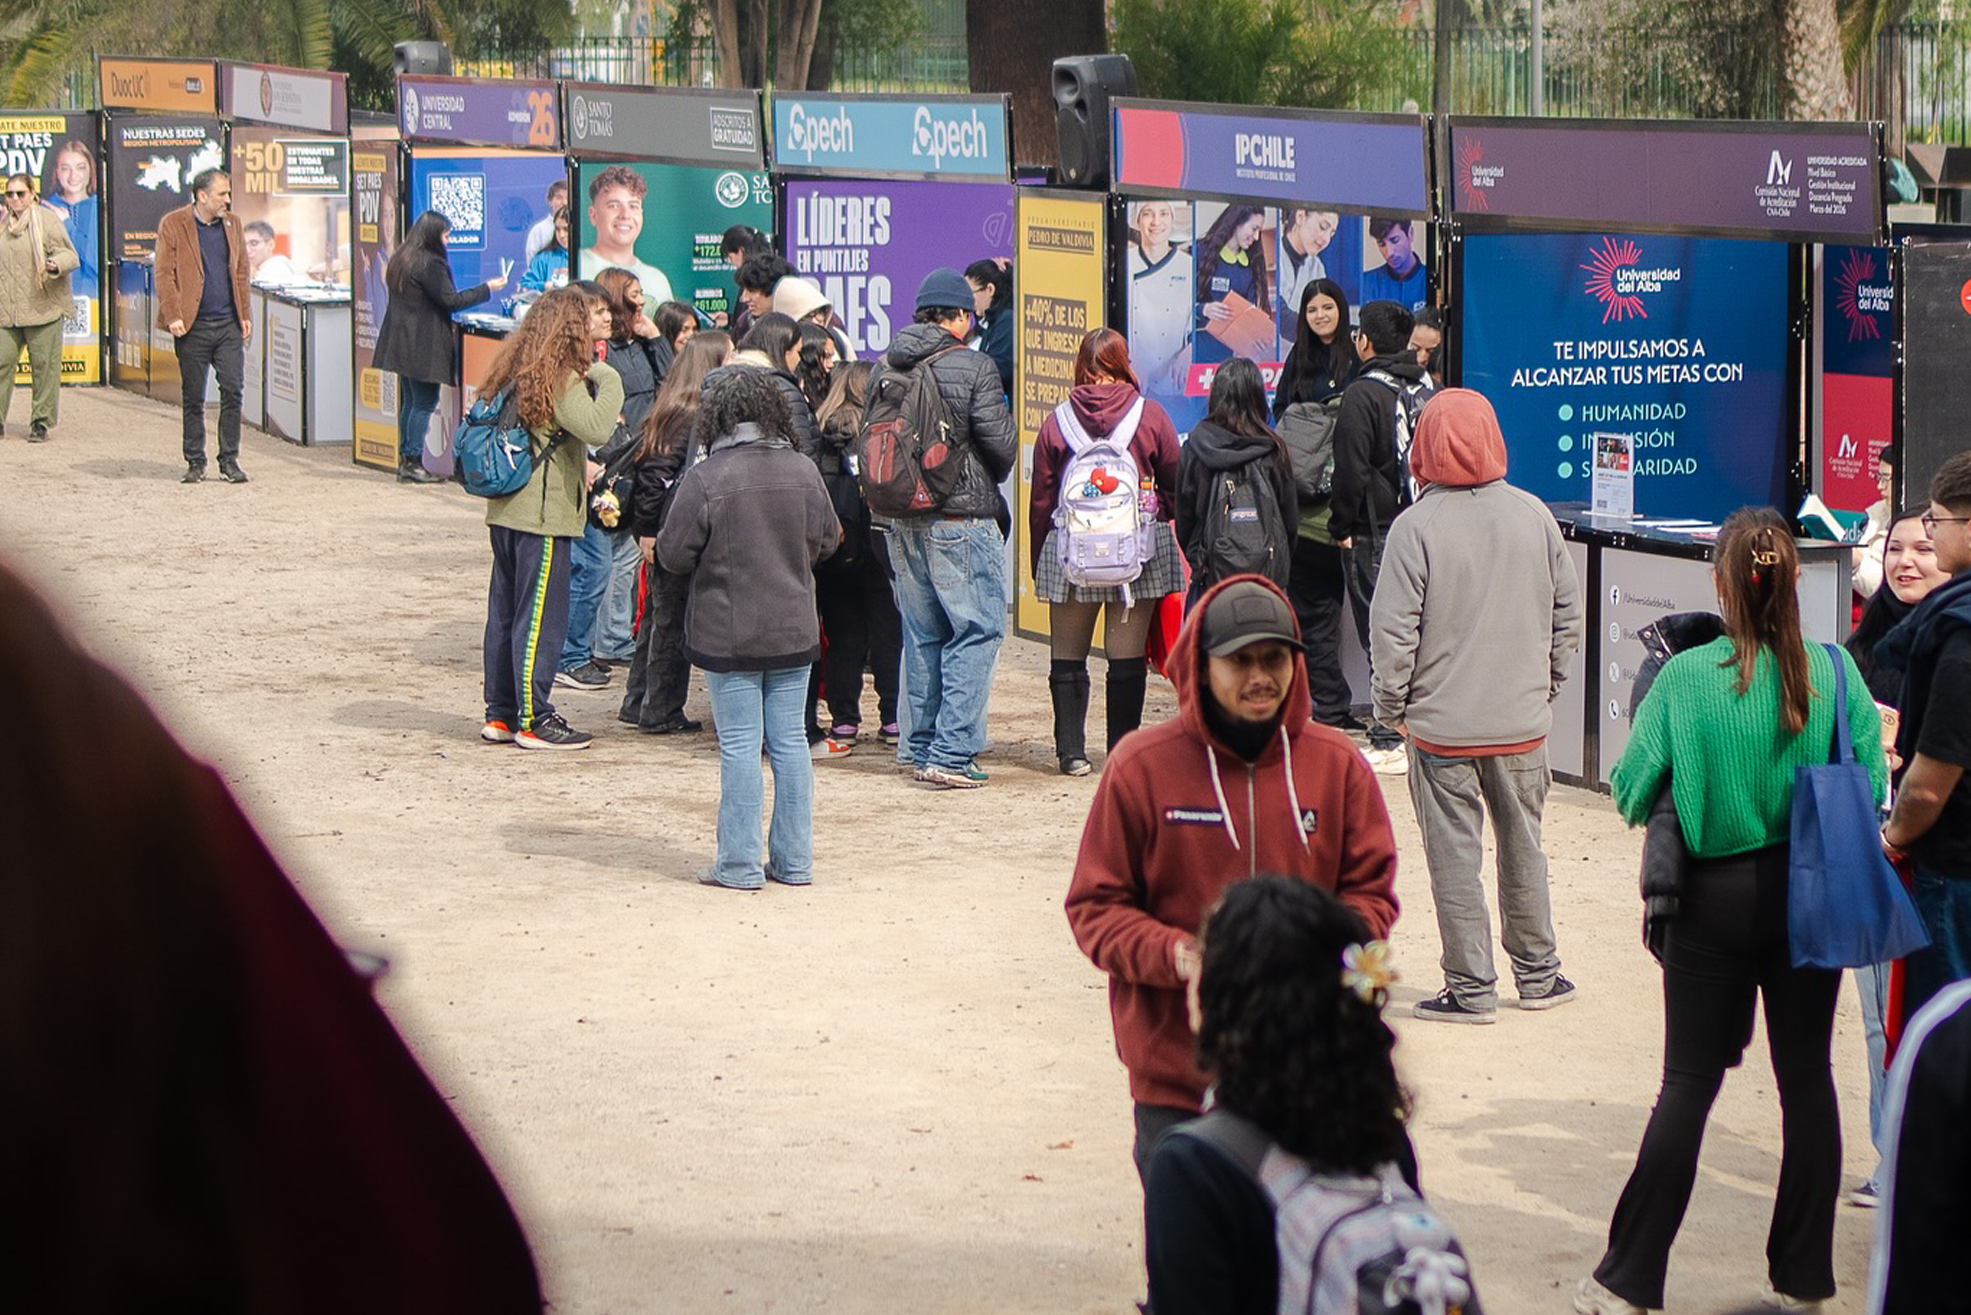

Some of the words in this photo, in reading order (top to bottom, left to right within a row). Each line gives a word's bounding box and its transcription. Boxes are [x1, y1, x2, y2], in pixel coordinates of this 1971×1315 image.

[421, 96, 465, 113] UNIVERSIDAD
[588, 101, 612, 118] SANTO
[20, 121, 62, 131] NUESTRO
[423, 114, 453, 130] CENTRAL
[528, 89, 556, 147] 26
[713, 114, 746, 128] ADSCRITOS
[14, 132, 53, 149] PAES
[123, 127, 175, 139] NUESTRAS
[176, 127, 206, 138] SEDES
[713, 128, 754, 145] GRATUIDAD
[287, 146, 335, 156] ESTUDIANTES
[1235, 133, 1296, 169] IPCHILE
[287, 156, 298, 165] EN
[298, 156, 322, 165] TODAS
[1807, 156, 1837, 165] UNIVERSIDAD
[1838, 157, 1868, 166] ACREDITADA
[287, 165, 324, 175] NUESTRAS
[1471, 165, 1505, 178] Universidad
[1807, 167, 1820, 177] Nivel
[245, 172, 284, 193] MIL
[356, 173, 367, 191] SET
[367, 172, 382, 190] PAES
[1827, 180, 1856, 191] Institucional
[1778, 186, 1800, 198] Nacional
[1808, 191, 1831, 202] Docencia
[360, 190, 380, 223] PDV
[1824, 204, 1833, 214] del
[797, 191, 891, 247] LÍDERES
[448, 235, 480, 244] ULADOR
[1028, 229, 1051, 245] PEDRO
[1051, 231, 1061, 246] DE
[1061, 232, 1094, 249] VALDIVIA
[797, 249, 812, 273] EN
[814, 248, 869, 273] PUNTAJES
[1616, 268, 1681, 282] Universidad
[1617, 280, 1635, 293] del
[1636, 280, 1662, 292] Alba
[1858, 284, 1894, 299] Universid
[1858, 298, 1871, 310] del
[1872, 299, 1890, 311] Alba
[804, 275, 892, 352] AES
[1026, 299, 1053, 327] +40%
[1055, 305, 1066, 327] DE
[1068, 306, 1085, 329] LOS
[1026, 328, 1042, 350] QUE
[1553, 341, 1574, 361] TE
[1578, 339, 1689, 361] IMPULSAMOS
[1692, 338, 1706, 358] A
[1026, 354, 1032, 375] A
[1511, 367, 1607, 387] ALCANZAR
[1611, 365, 1643, 385] TUS
[1647, 364, 1700, 384] METAS
[1704, 362, 1744, 383] CON
[1026, 380, 1036, 401] SE
[1582, 402, 1688, 422] HUMANIDAD
[1582, 457, 1698, 479] SARIDAD
